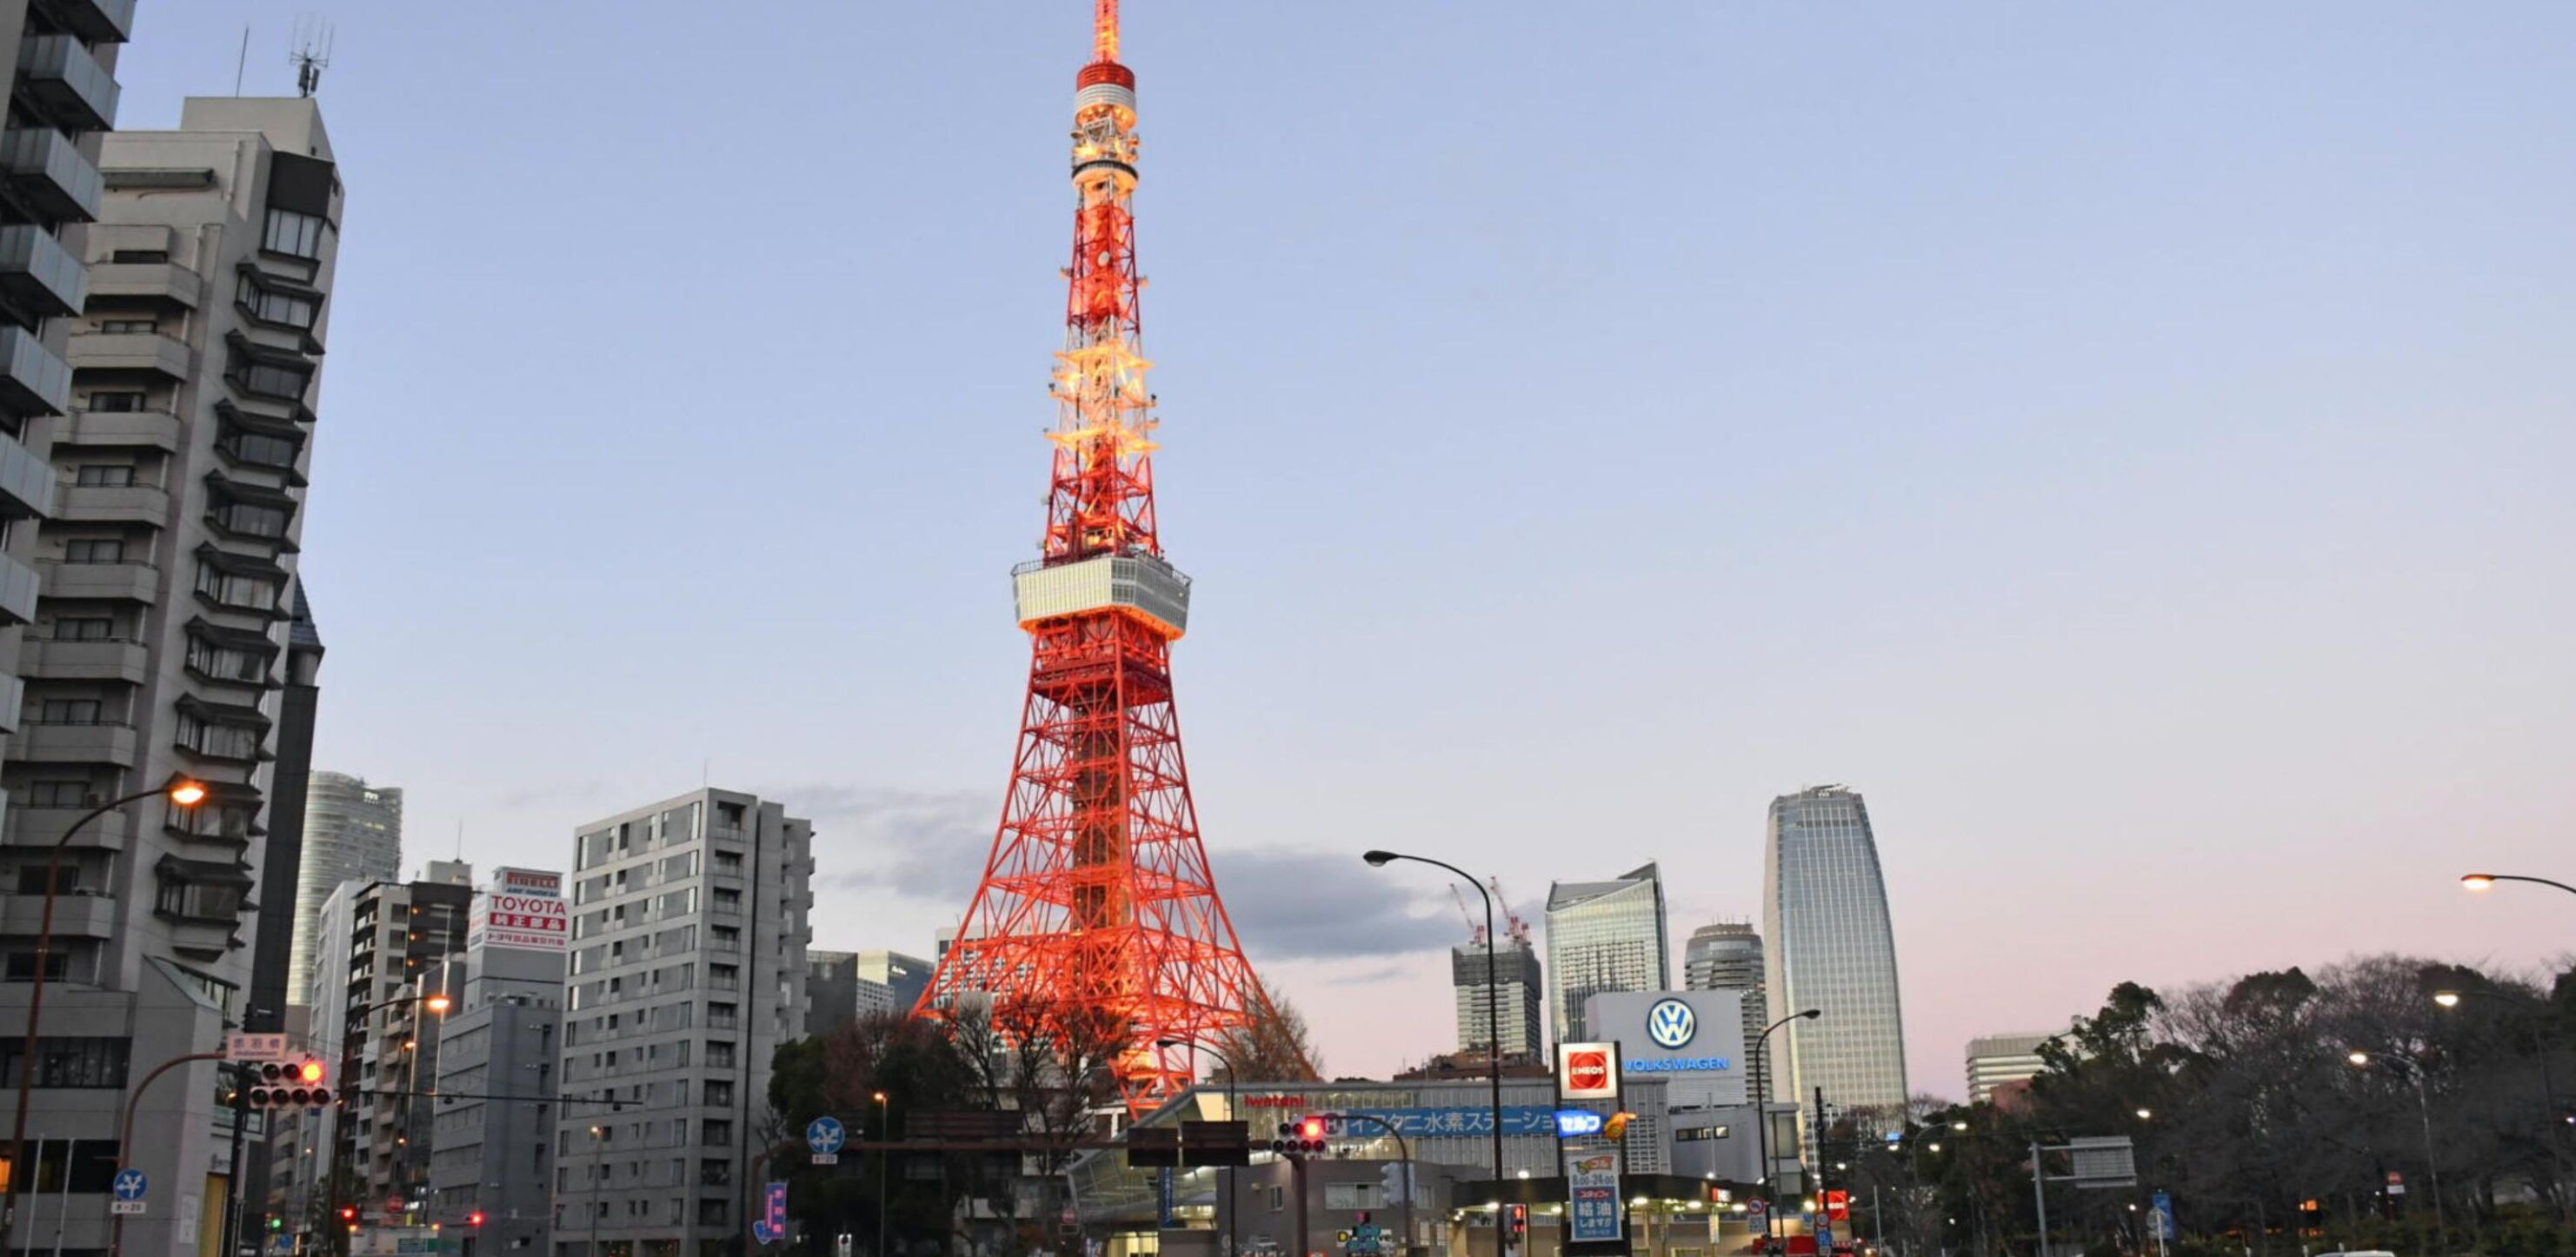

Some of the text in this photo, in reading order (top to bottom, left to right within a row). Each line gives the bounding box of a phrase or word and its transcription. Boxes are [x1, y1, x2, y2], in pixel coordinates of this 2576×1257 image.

[491, 895, 566, 914] TOYOTA
[494, 913, 562, 930] 純正部品
[1571, 1067, 1605, 1076] ENEOS
[1624, 1057, 1728, 1071] VOLKSWAGEN
[1350, 1112, 1555, 1134] イワタニ水素ステーショ
[1559, 1114, 1601, 1131] セルフ
[1578, 1201, 1612, 1216] 給油
